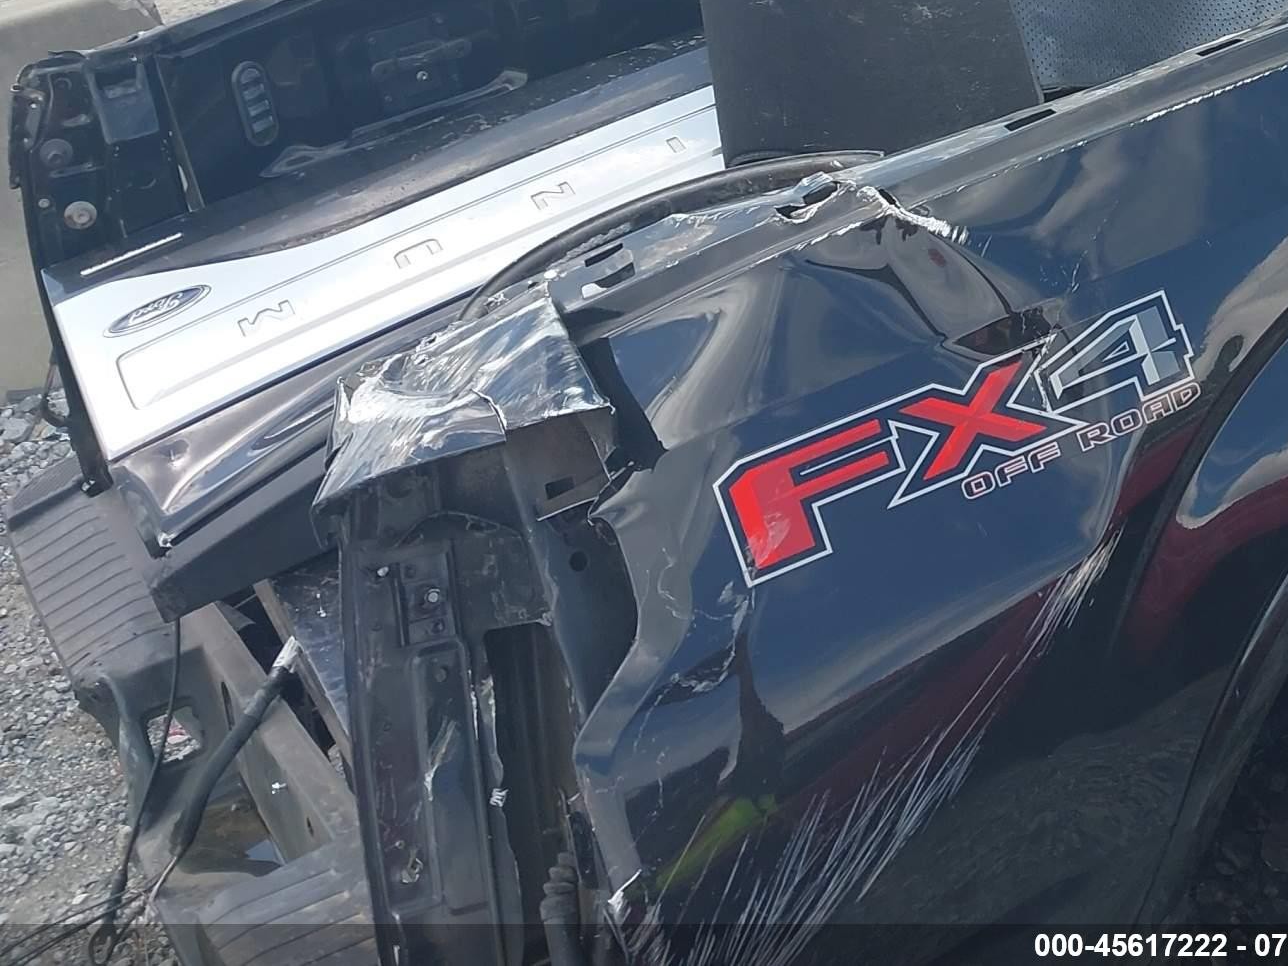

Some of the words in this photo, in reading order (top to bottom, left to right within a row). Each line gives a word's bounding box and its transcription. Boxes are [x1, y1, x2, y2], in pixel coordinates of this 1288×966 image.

[713, 290, 1196, 588] FX4
[961, 442, 1061, 500] OFF
[1077, 382, 1201, 452] ROAD
